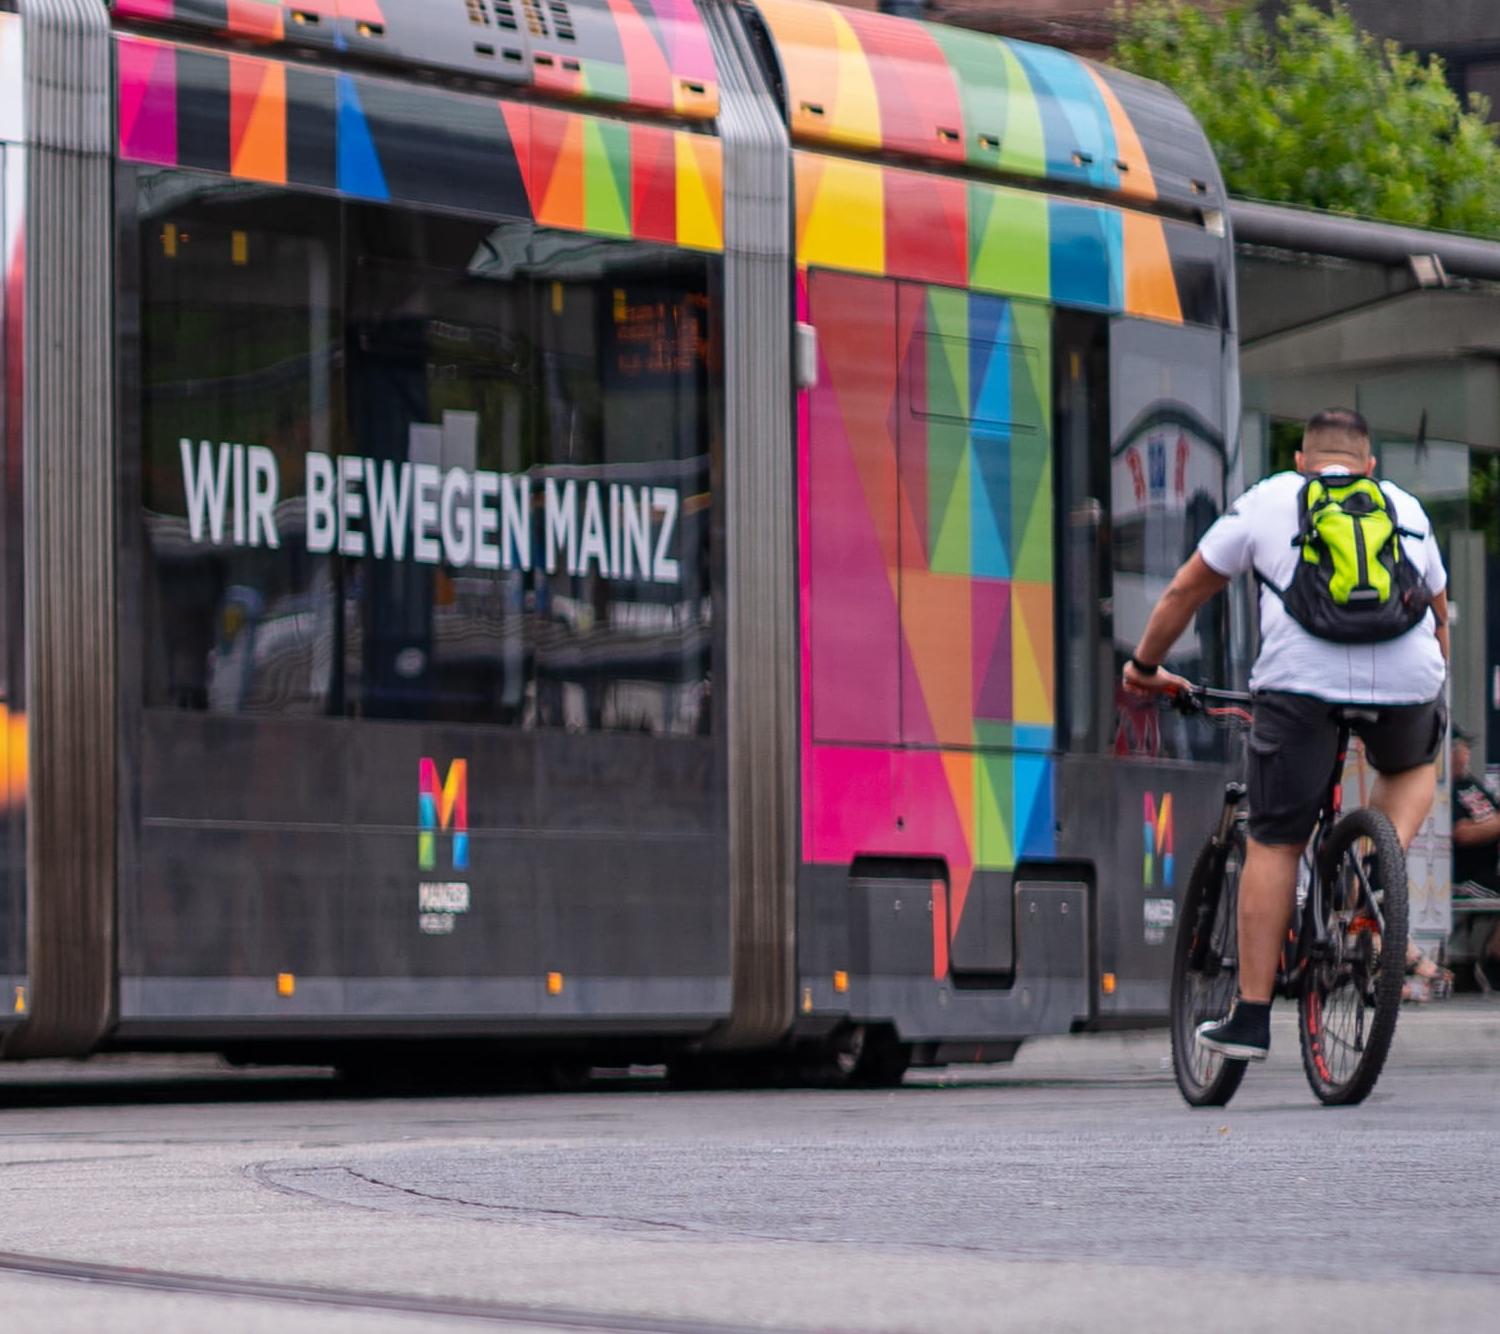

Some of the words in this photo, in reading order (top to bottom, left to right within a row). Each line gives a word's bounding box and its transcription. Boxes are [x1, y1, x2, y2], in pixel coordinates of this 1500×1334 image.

[180, 438, 281, 550] WIR
[306, 451, 531, 570] BEWEGEN
[545, 477, 678, 583] MAINZ
